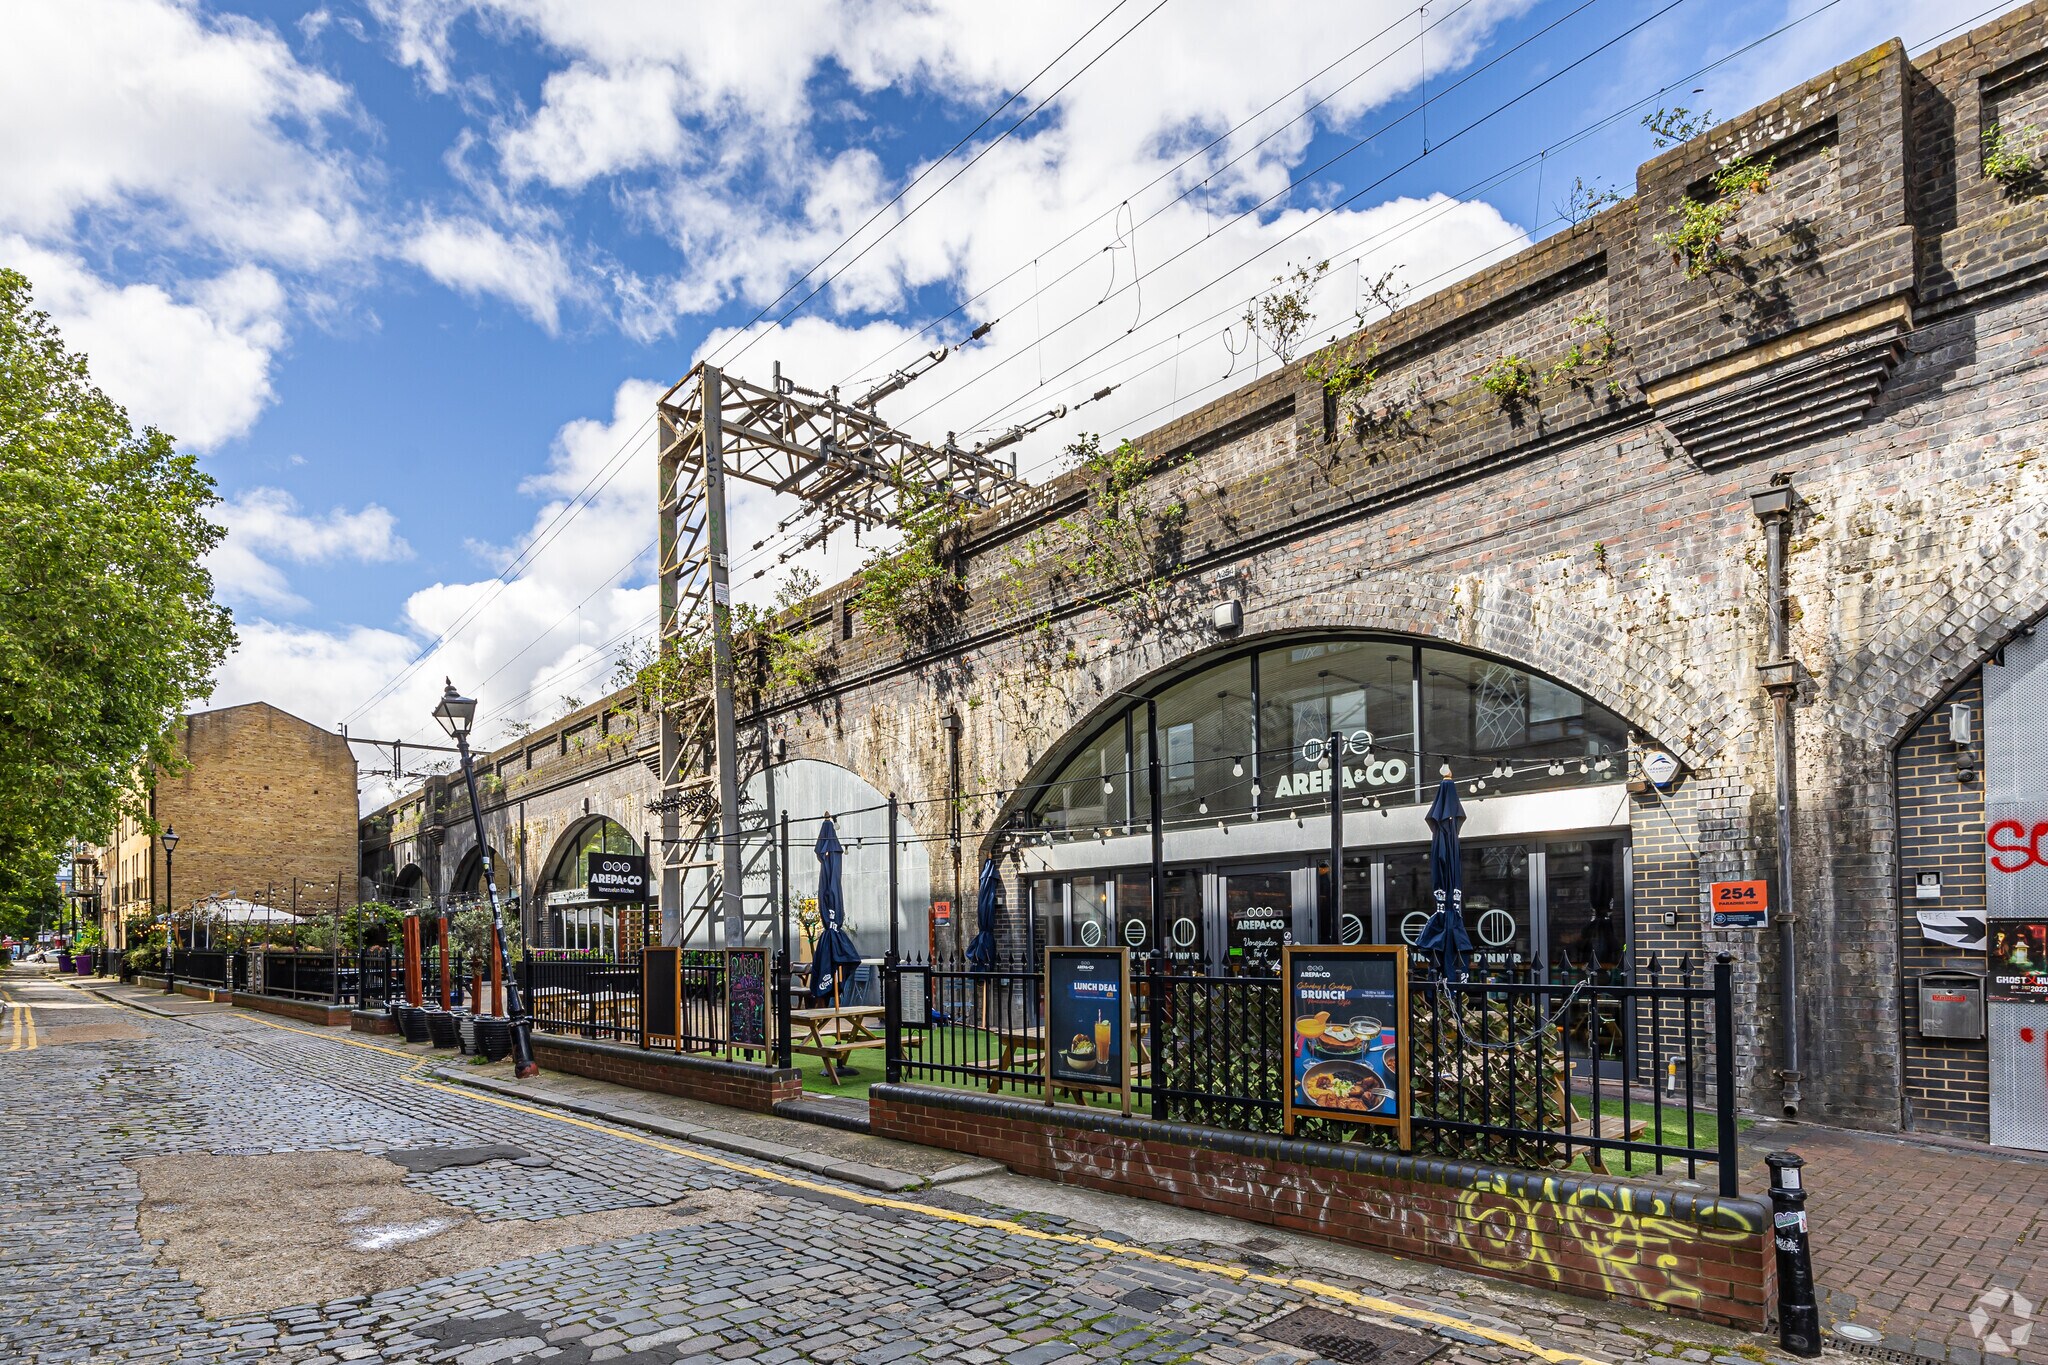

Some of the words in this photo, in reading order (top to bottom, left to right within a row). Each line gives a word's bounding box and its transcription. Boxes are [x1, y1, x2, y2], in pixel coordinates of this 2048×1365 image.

[590, 873, 642, 886] AREPA&CO
[1720, 887, 1756, 900] 254
[1236, 920, 1285, 930] AREPA&CO
[1996, 976, 2026, 984] GHOST
[1074, 982, 1098, 991] LUNCH
[1099, 983, 1118, 992] DEAL
[1301, 989, 1346, 1000] BRUNCH
